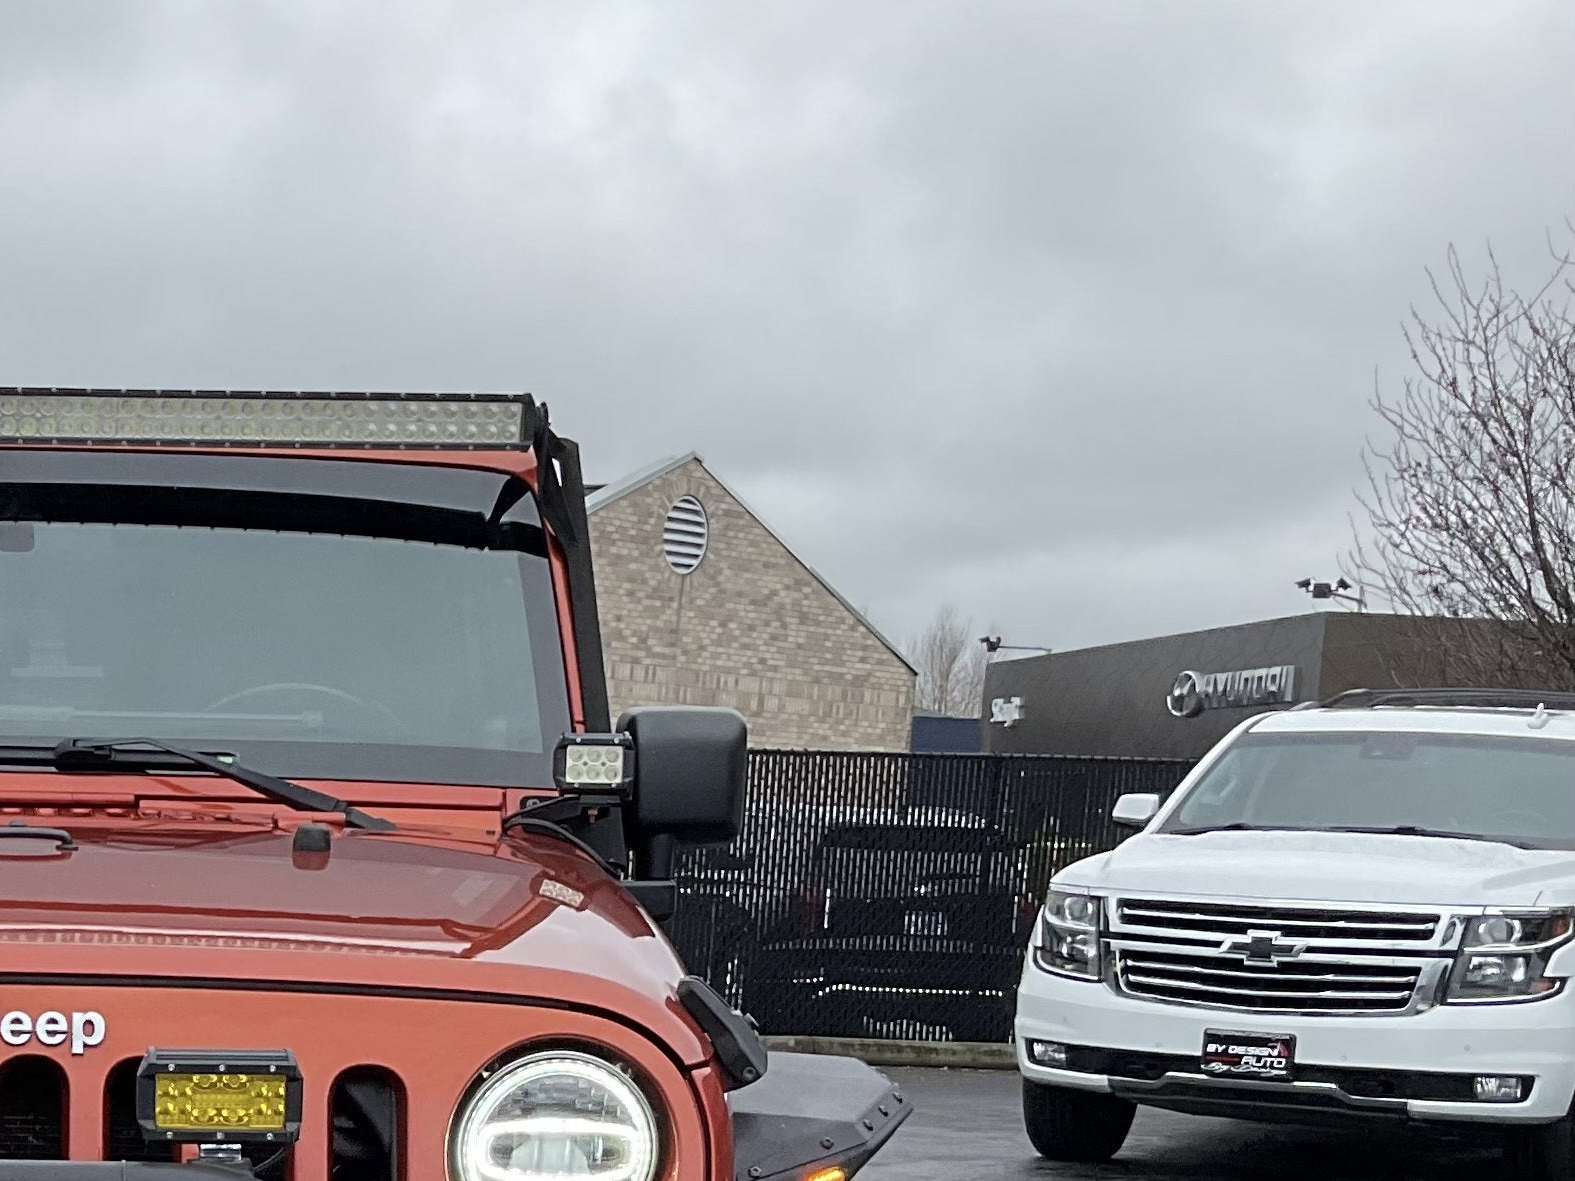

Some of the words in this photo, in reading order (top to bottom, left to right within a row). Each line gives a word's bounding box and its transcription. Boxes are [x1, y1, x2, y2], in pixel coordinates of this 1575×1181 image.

[1199, 664, 1295, 706] HYUNDAI
[1206, 1043, 1227, 1053] BY
[1228, 1044, 1280, 1057] DESIGN
[1240, 1055, 1287, 1068] AUTO
